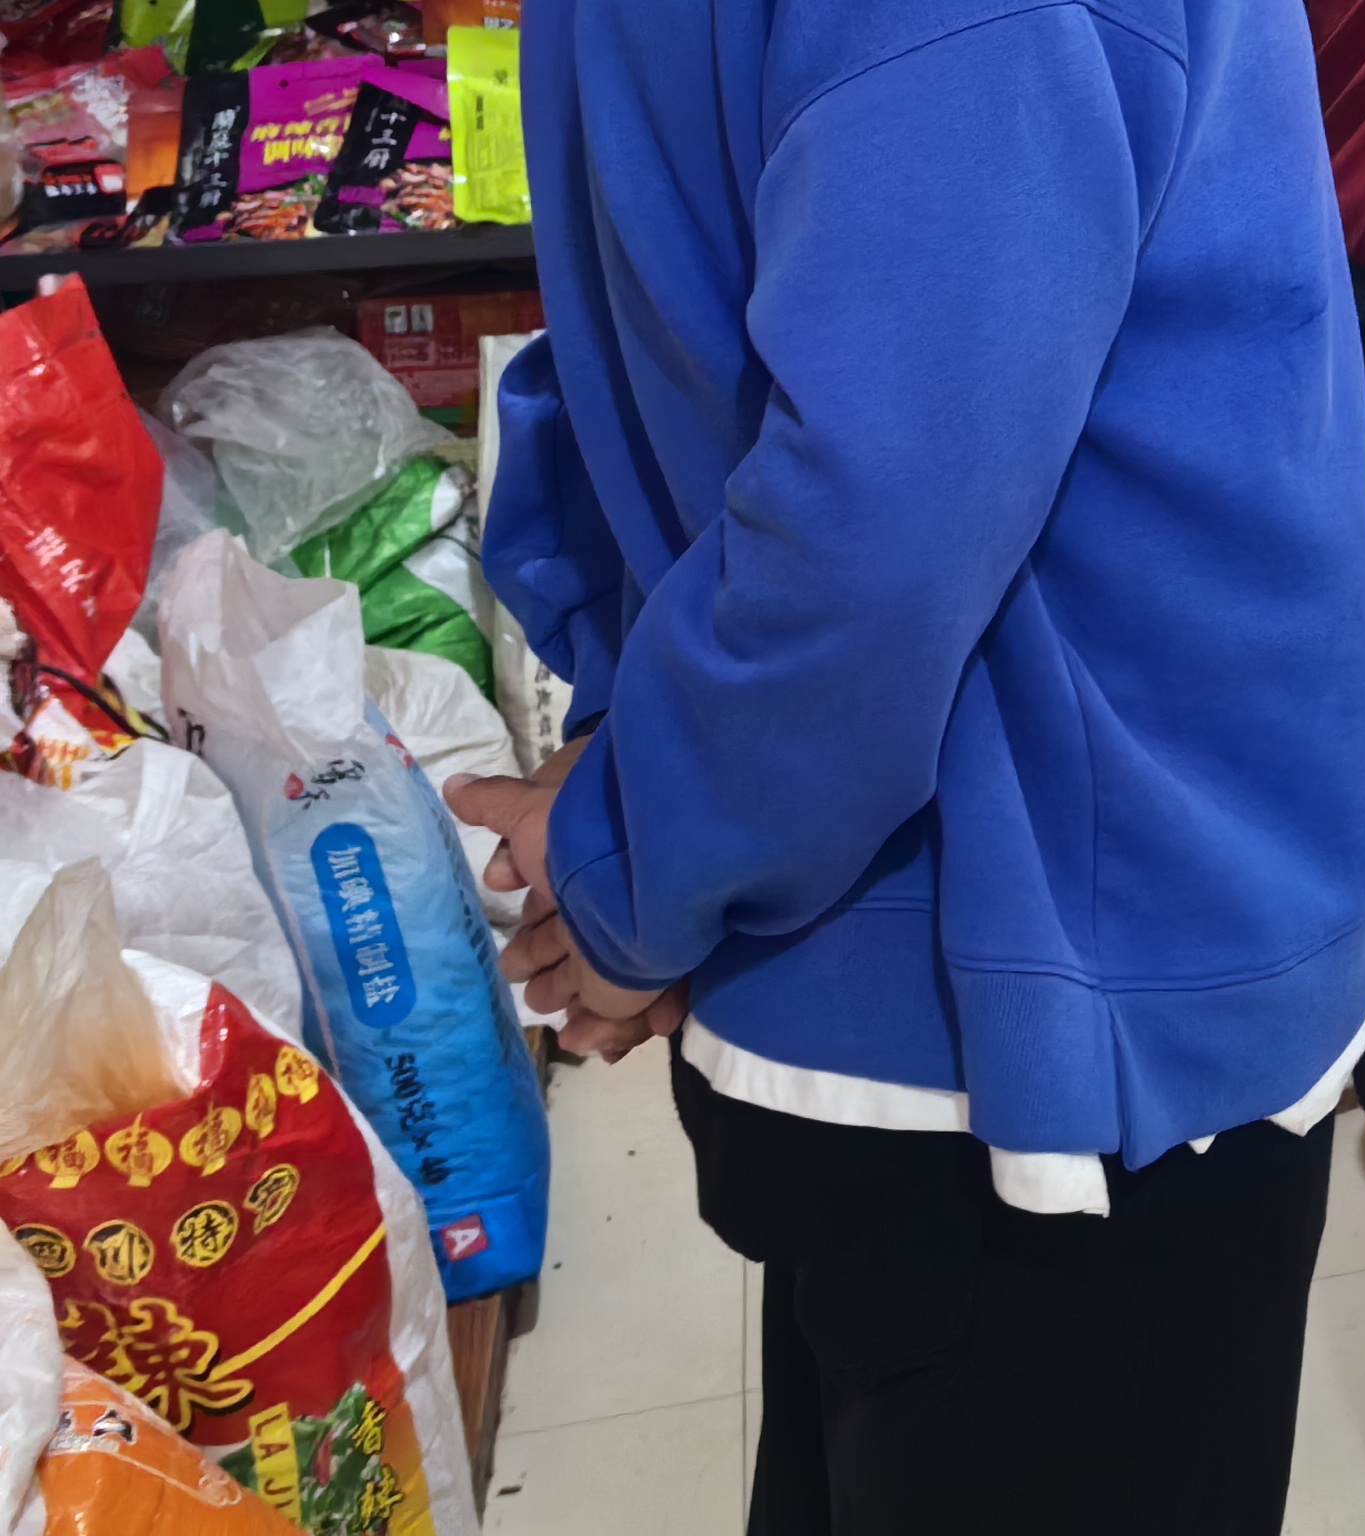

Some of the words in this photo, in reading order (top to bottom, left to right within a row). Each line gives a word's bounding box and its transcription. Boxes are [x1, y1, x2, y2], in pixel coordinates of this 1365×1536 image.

[325, 845, 401, 1009] 加碘精制盐
